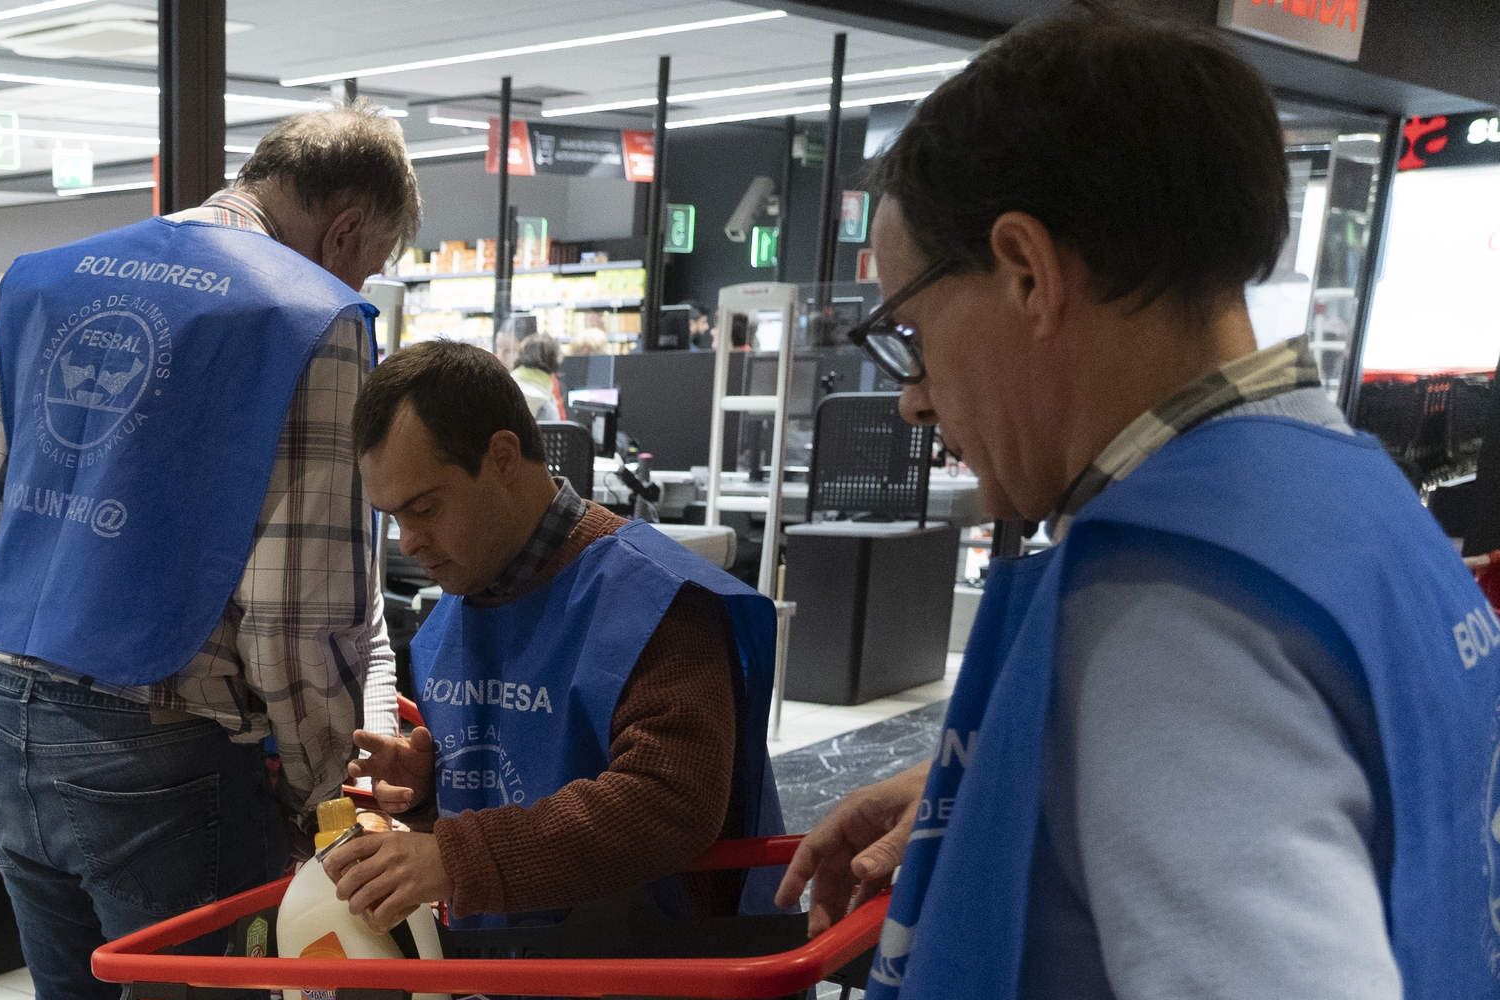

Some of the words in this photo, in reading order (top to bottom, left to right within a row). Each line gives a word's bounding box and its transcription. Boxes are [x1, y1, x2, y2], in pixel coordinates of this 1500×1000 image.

[74, 255, 232, 297] BOLONDRESA
[43, 298, 102, 361] BANCOS
[106, 293, 130, 309] DE
[130, 295, 173, 380] ALIMENTOS
[79, 328, 141, 354] FESBAL
